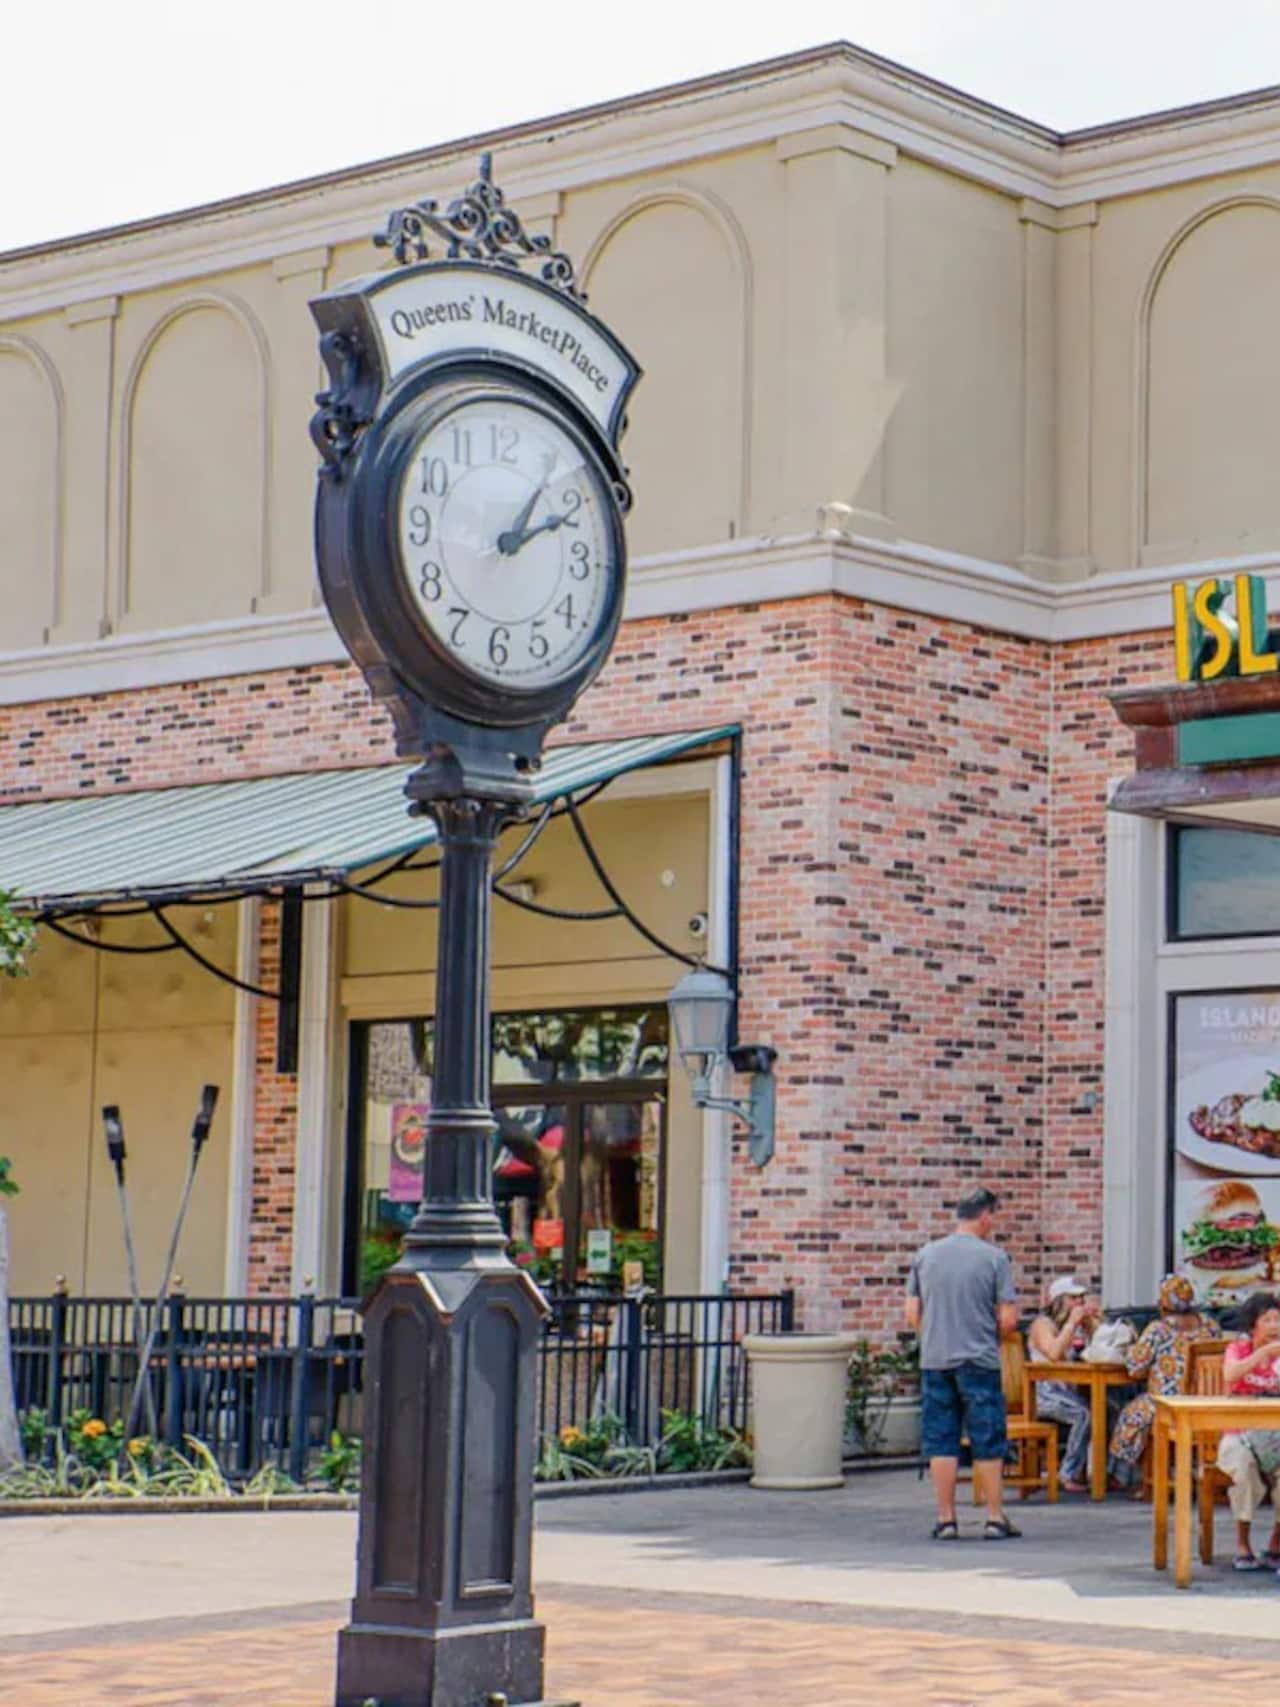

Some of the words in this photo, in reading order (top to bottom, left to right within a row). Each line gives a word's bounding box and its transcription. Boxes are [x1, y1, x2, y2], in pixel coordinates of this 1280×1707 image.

[390, 294, 476, 340] Queens'
[482, 296, 609, 393] MarketPlace
[490, 424, 521, 464] 12
[421, 456, 449, 497] 10
[408, 505, 431, 546] 9
[562, 488, 582, 528] 2
[568, 541, 590, 581] 3
[419, 561, 442, 602] 8
[447, 607, 470, 648] 7
[554, 593, 577, 630] 4
[488, 626, 510, 666] 6
[527, 620, 549, 658] 5
